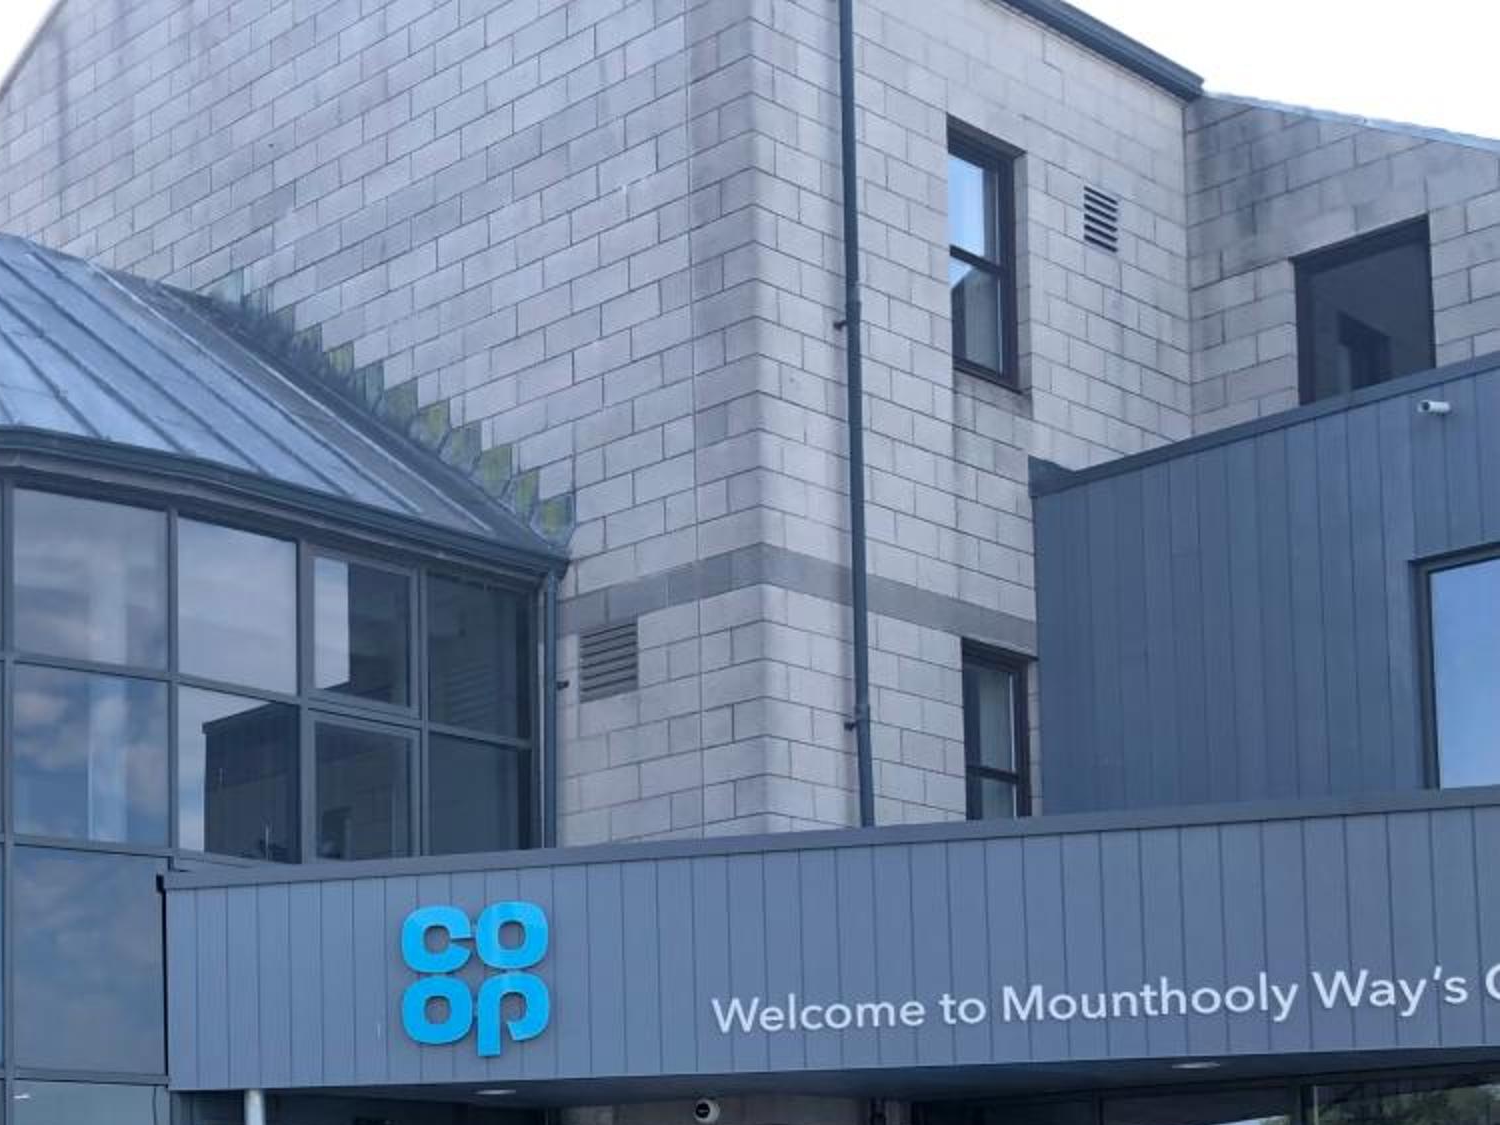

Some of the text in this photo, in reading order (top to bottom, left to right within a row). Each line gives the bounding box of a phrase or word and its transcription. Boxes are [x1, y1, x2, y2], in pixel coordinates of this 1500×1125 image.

[711, 993, 926, 1034] Welcome
[938, 993, 986, 1025] to
[1002, 971, 1298, 1022] Mounthooly
[1311, 965, 1468, 1018] Way's
